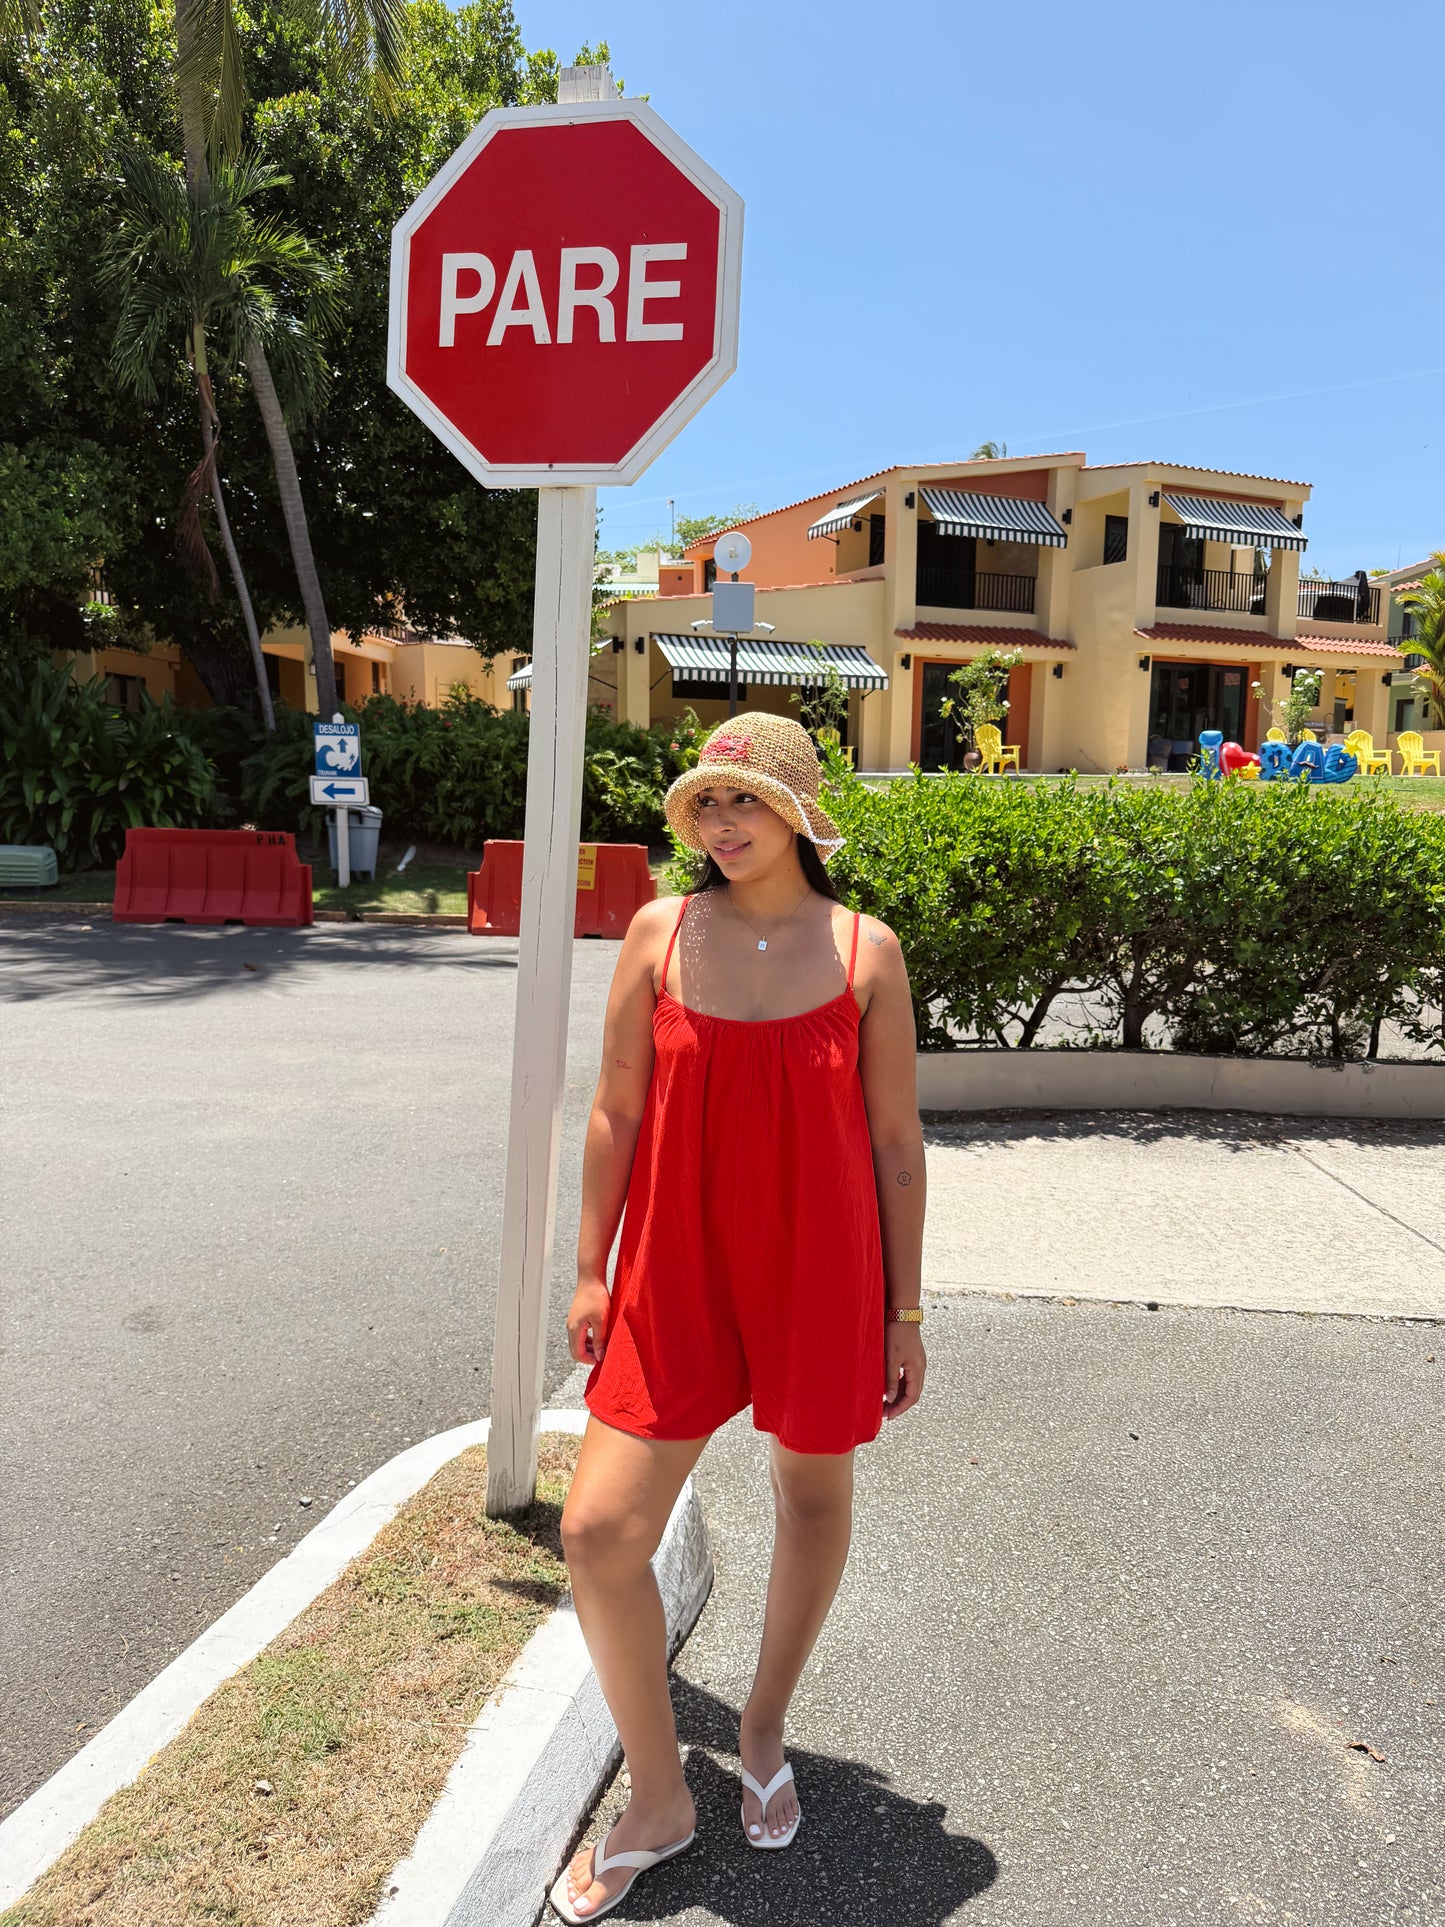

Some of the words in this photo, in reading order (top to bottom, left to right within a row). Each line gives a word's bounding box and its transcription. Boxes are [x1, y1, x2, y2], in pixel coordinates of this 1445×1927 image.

[438, 242, 688, 348] PARE
[318, 725, 355, 735] DESALOJO
[1260, 741, 1358, 784] DAD
